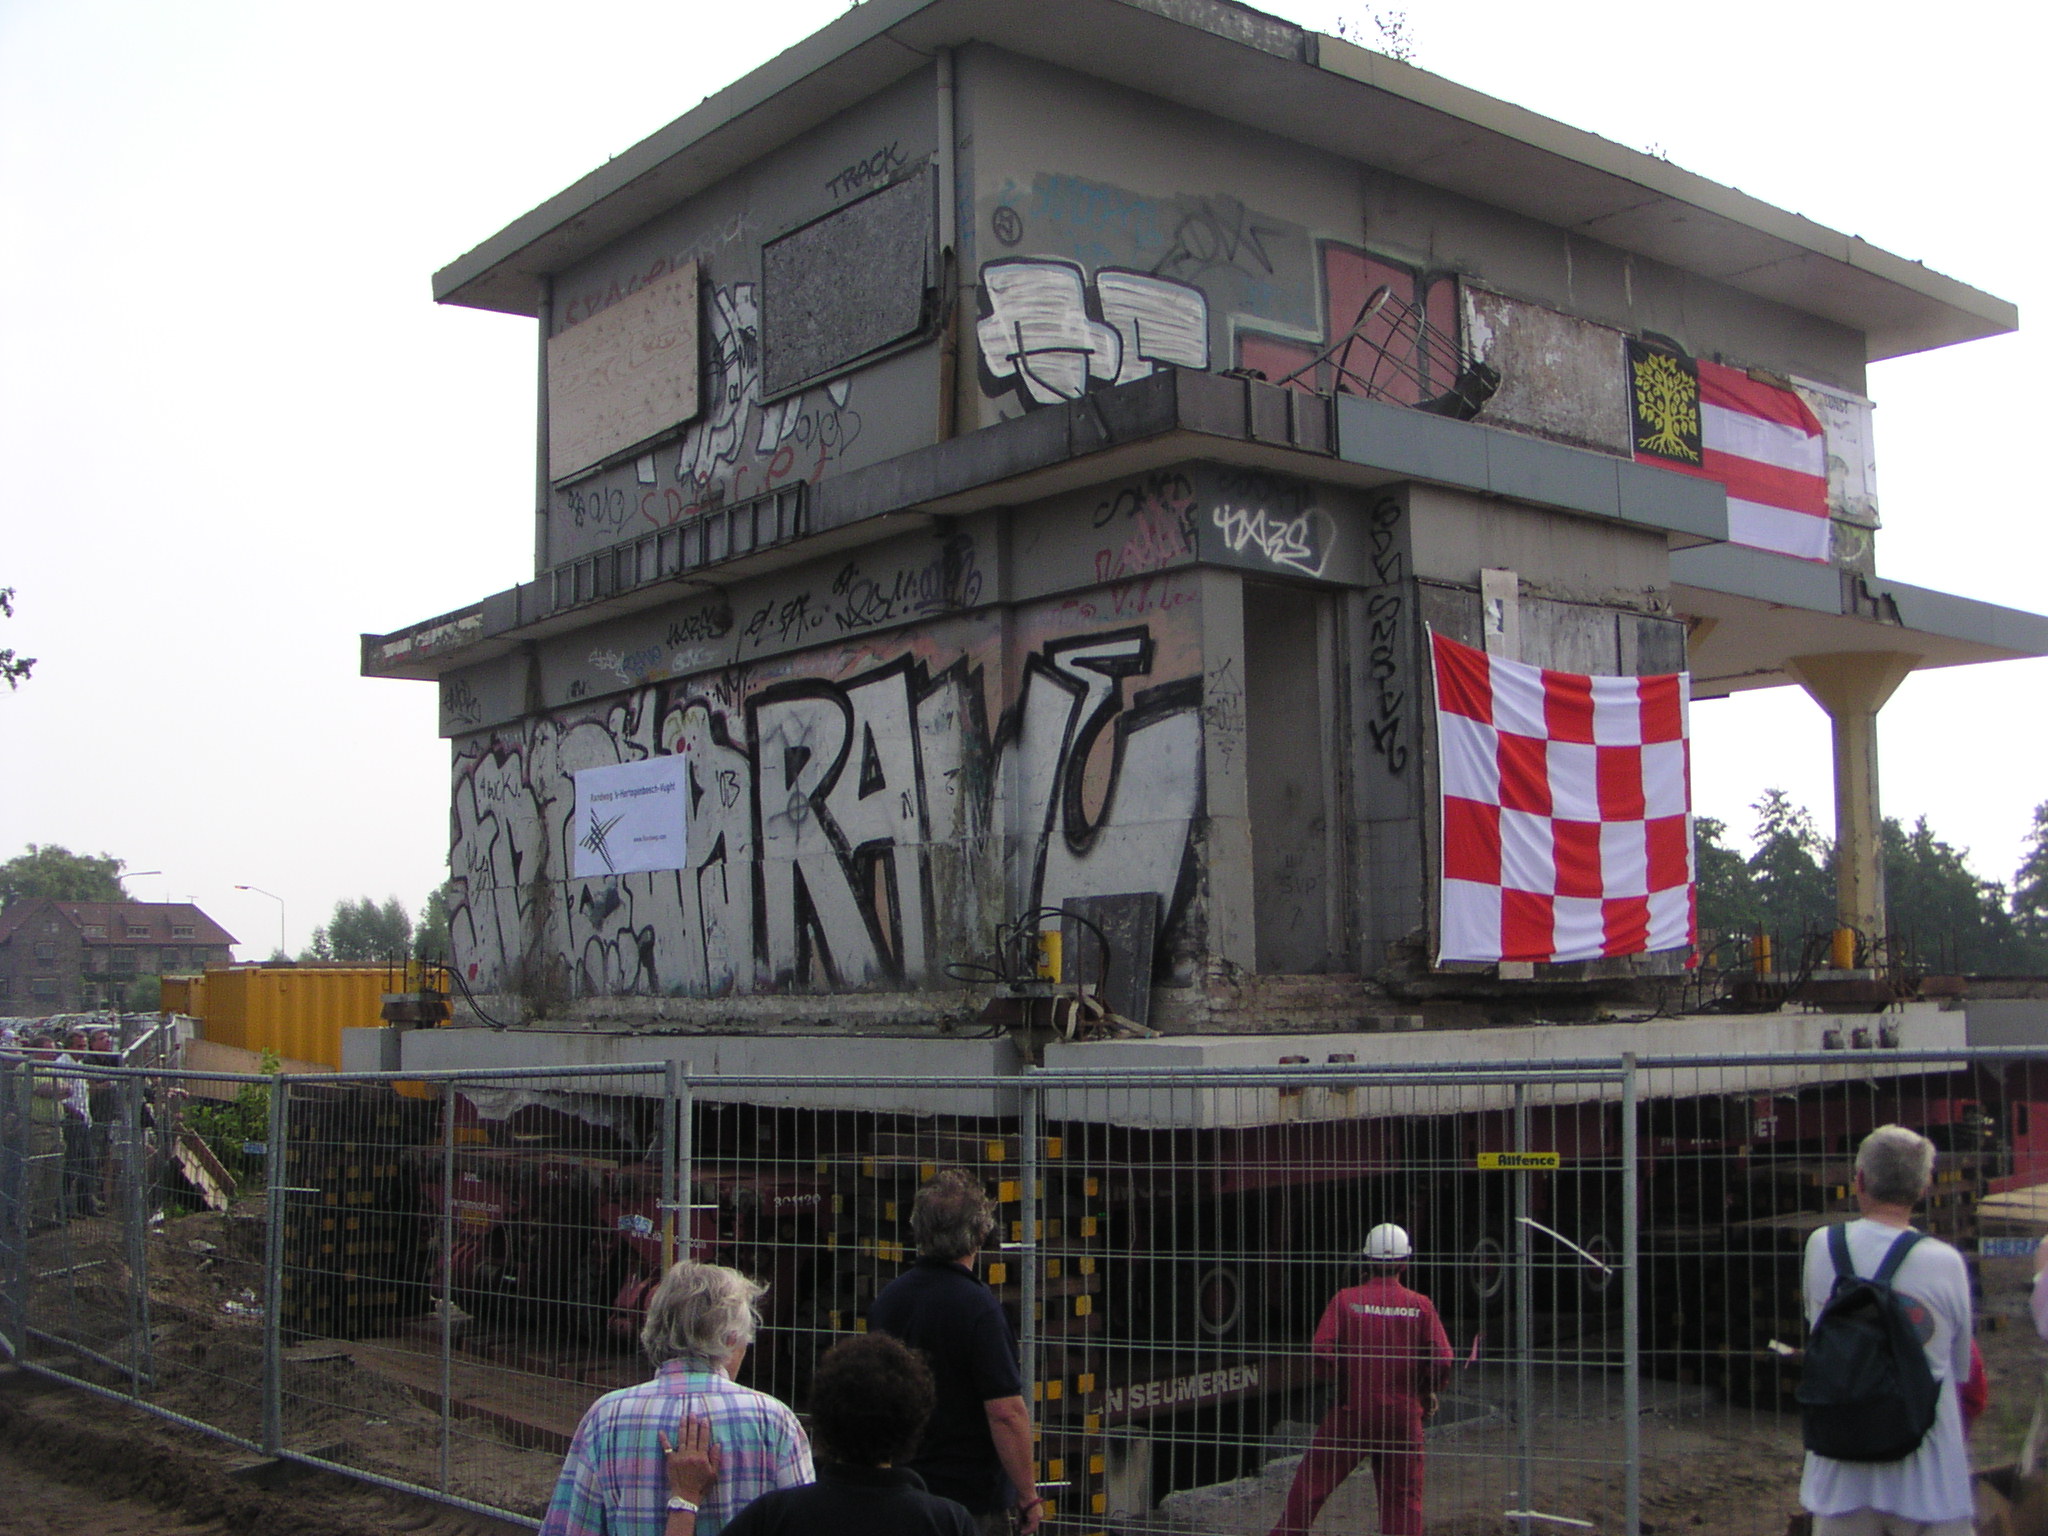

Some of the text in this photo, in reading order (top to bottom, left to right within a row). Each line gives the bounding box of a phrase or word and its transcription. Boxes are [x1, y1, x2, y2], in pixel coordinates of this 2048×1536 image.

[825, 141, 909, 198] TRACK
[1498, 1154, 1555, 1166] Allfence
[1364, 1304, 1421, 1318] MAMMOET
[1129, 1364, 1259, 1409] SEUMEREN
